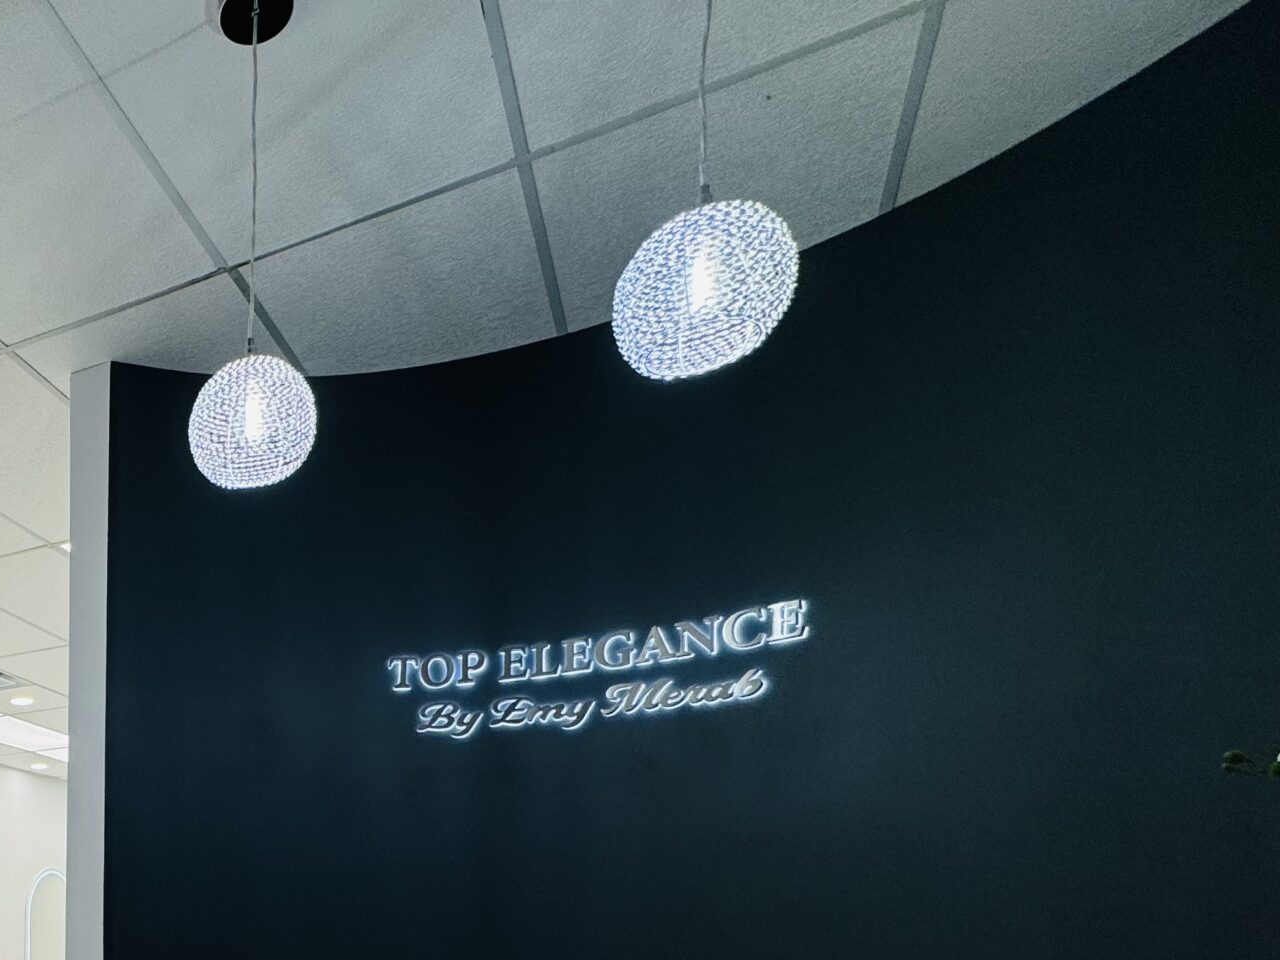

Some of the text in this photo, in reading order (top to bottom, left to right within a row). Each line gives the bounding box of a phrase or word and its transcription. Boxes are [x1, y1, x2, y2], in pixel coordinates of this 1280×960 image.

[388, 599, 810, 692] TOP ELEGANCE
[417, 701, 483, 739] By
[490, 695, 596, 731] Emy
